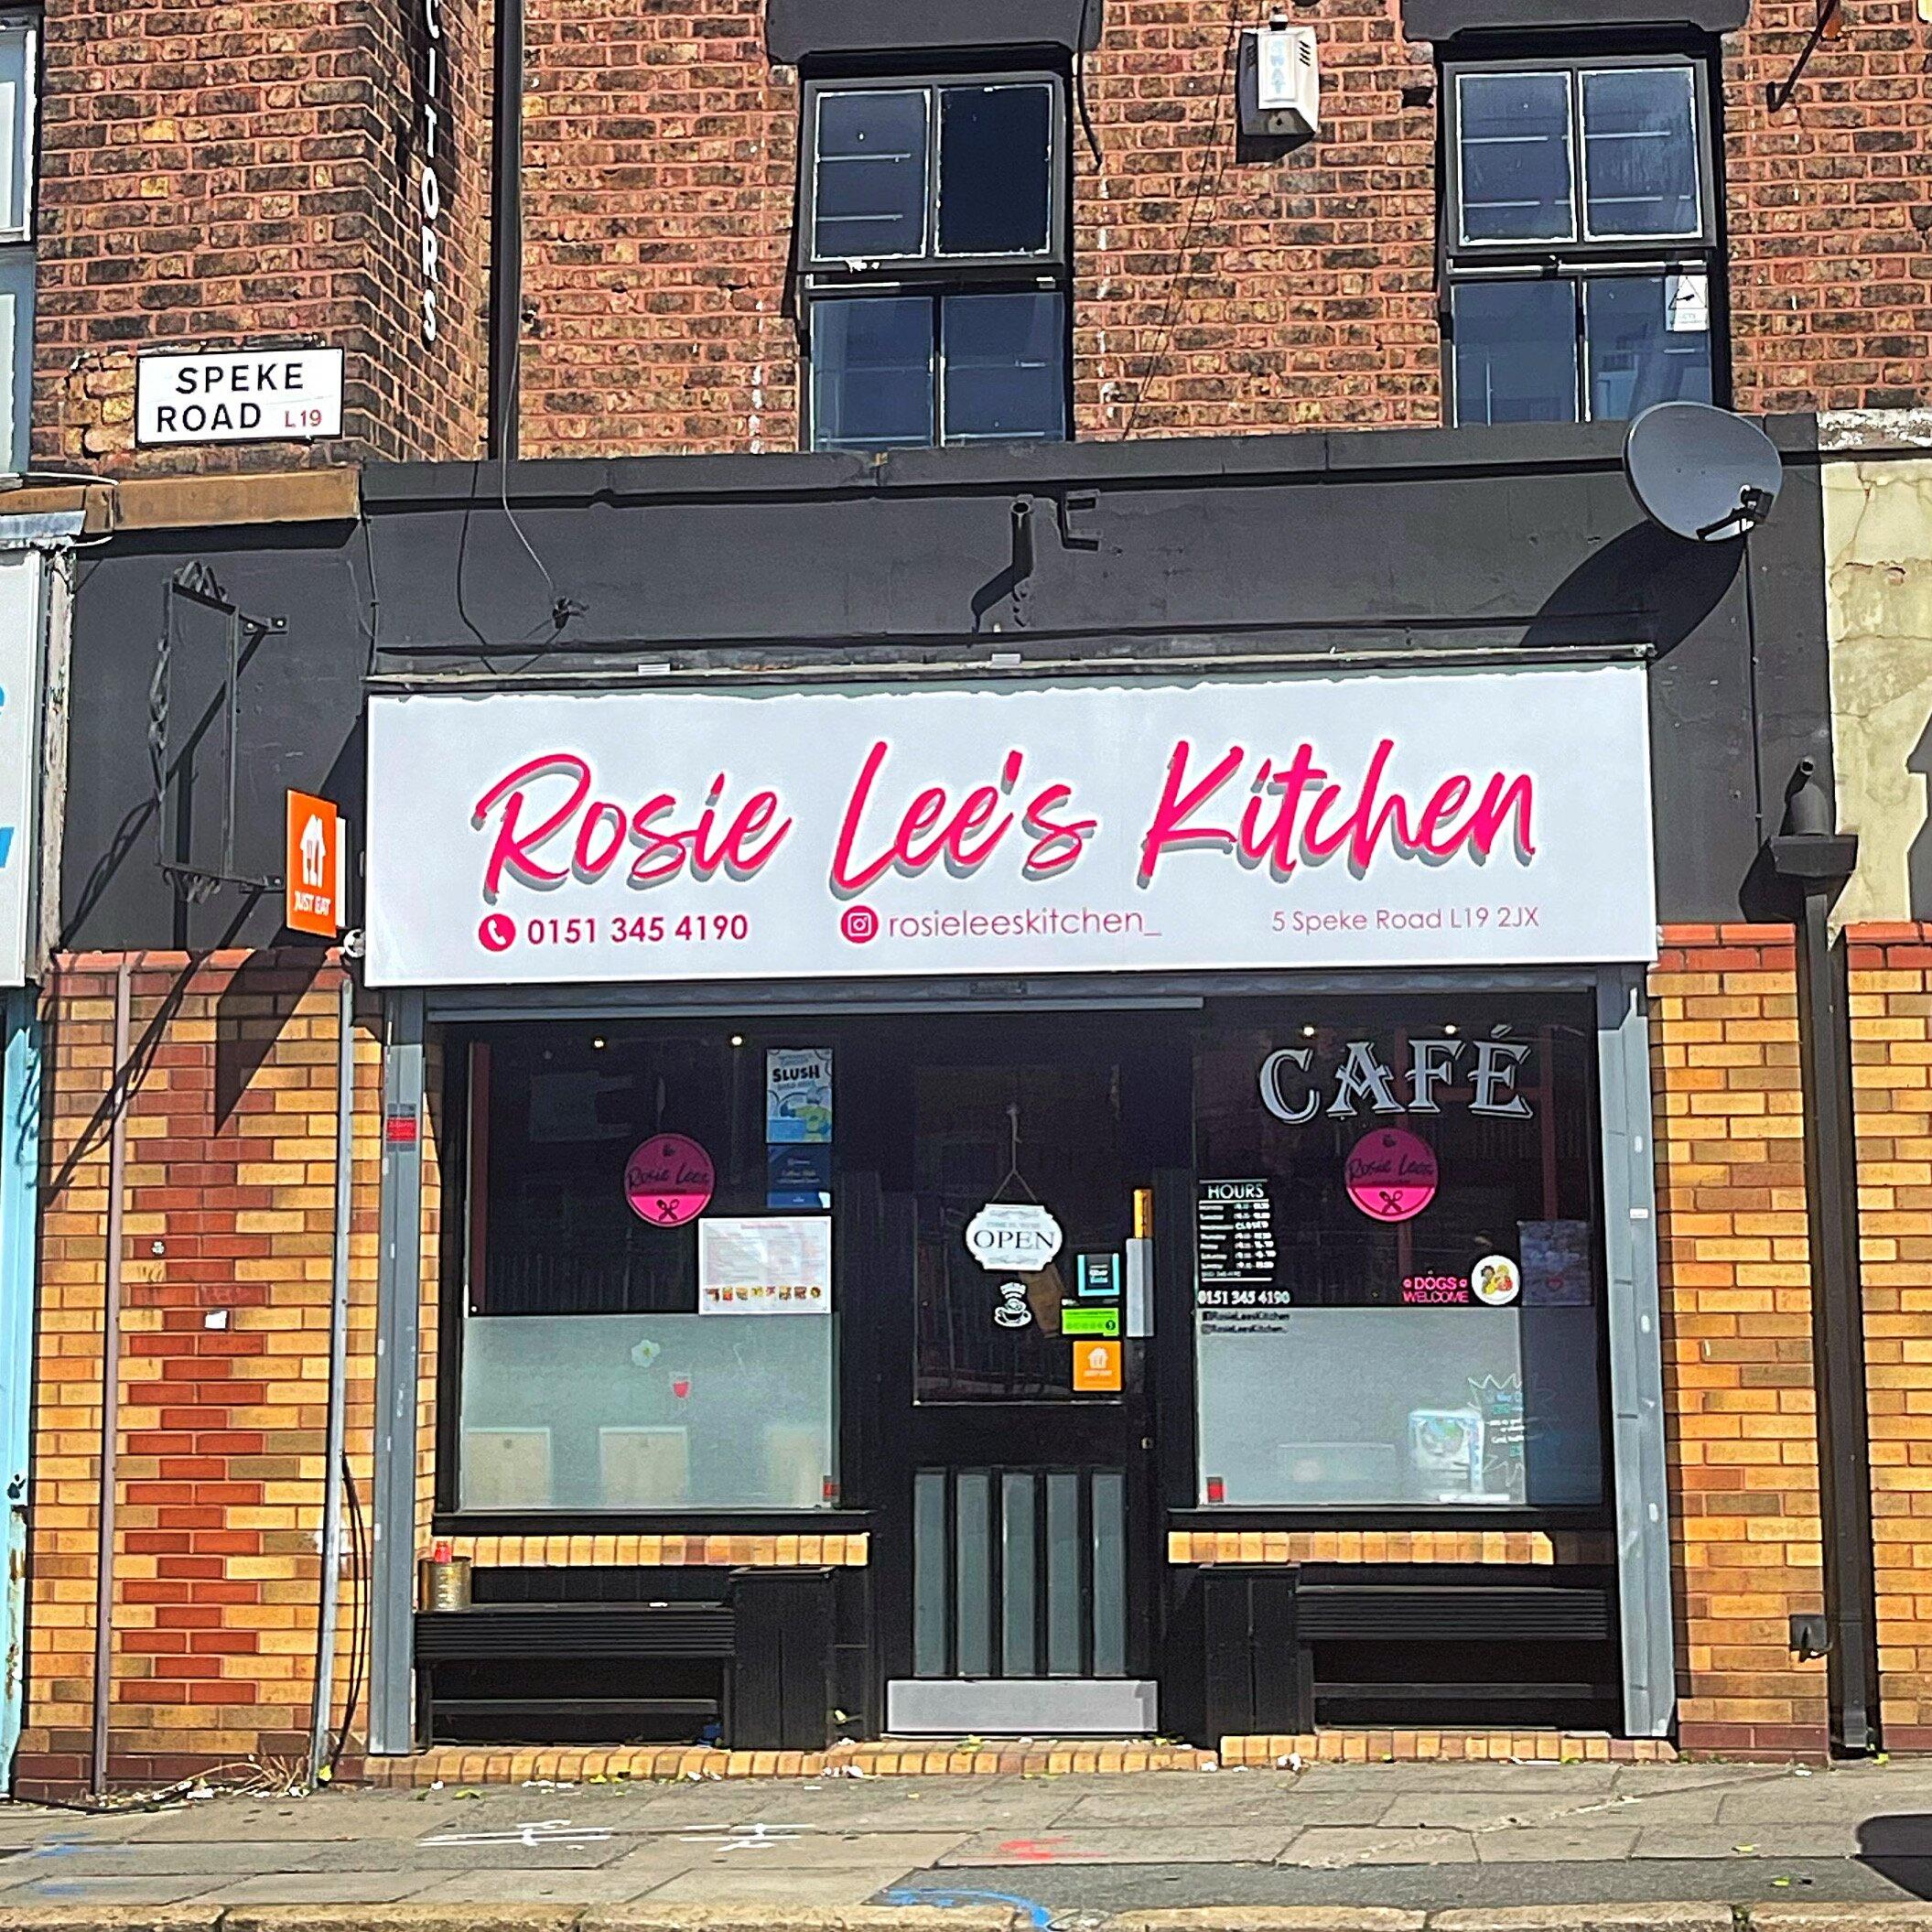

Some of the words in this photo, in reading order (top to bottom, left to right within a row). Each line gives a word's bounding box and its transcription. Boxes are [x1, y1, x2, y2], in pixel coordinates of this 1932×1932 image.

[176, 362, 304, 395] SPEKE
[157, 403, 262, 433] ROAD
[284, 409, 322, 428] L19
[470, 752, 793, 905] Rosie
[829, 740, 1097, 901] Lee's
[1137, 739, 1536, 890] Kitchen
[294, 890, 314, 912] JUST
[315, 895, 331, 917] EAT
[527, 918, 597, 945] 0151
[611, 916, 665, 944] 345
[675, 913, 749, 943] 4190
[889, 907, 1162, 939] rosieleeskitchen_
[1272, 912, 1285, 933] 5
[1293, 911, 1367, 935] Speke
[1376, 907, 1441, 931] Road
[1450, 908, 1489, 930] L19
[1497, 906, 1540, 929] 2JX
[772, 1064, 821, 1084] SLUSH
[1259, 1024, 1534, 1124] CAFÉ
[1208, 1183, 1265, 1199] HOURS
[974, 1229, 1054, 1250] OPEN
[1197, 1290, 1229, 1304] 0151
[1231, 1290, 1257, 1305] 345
[1403, 1290, 1469, 1303] WELCOME
[1414, 1277, 1457, 1290] DOGS
